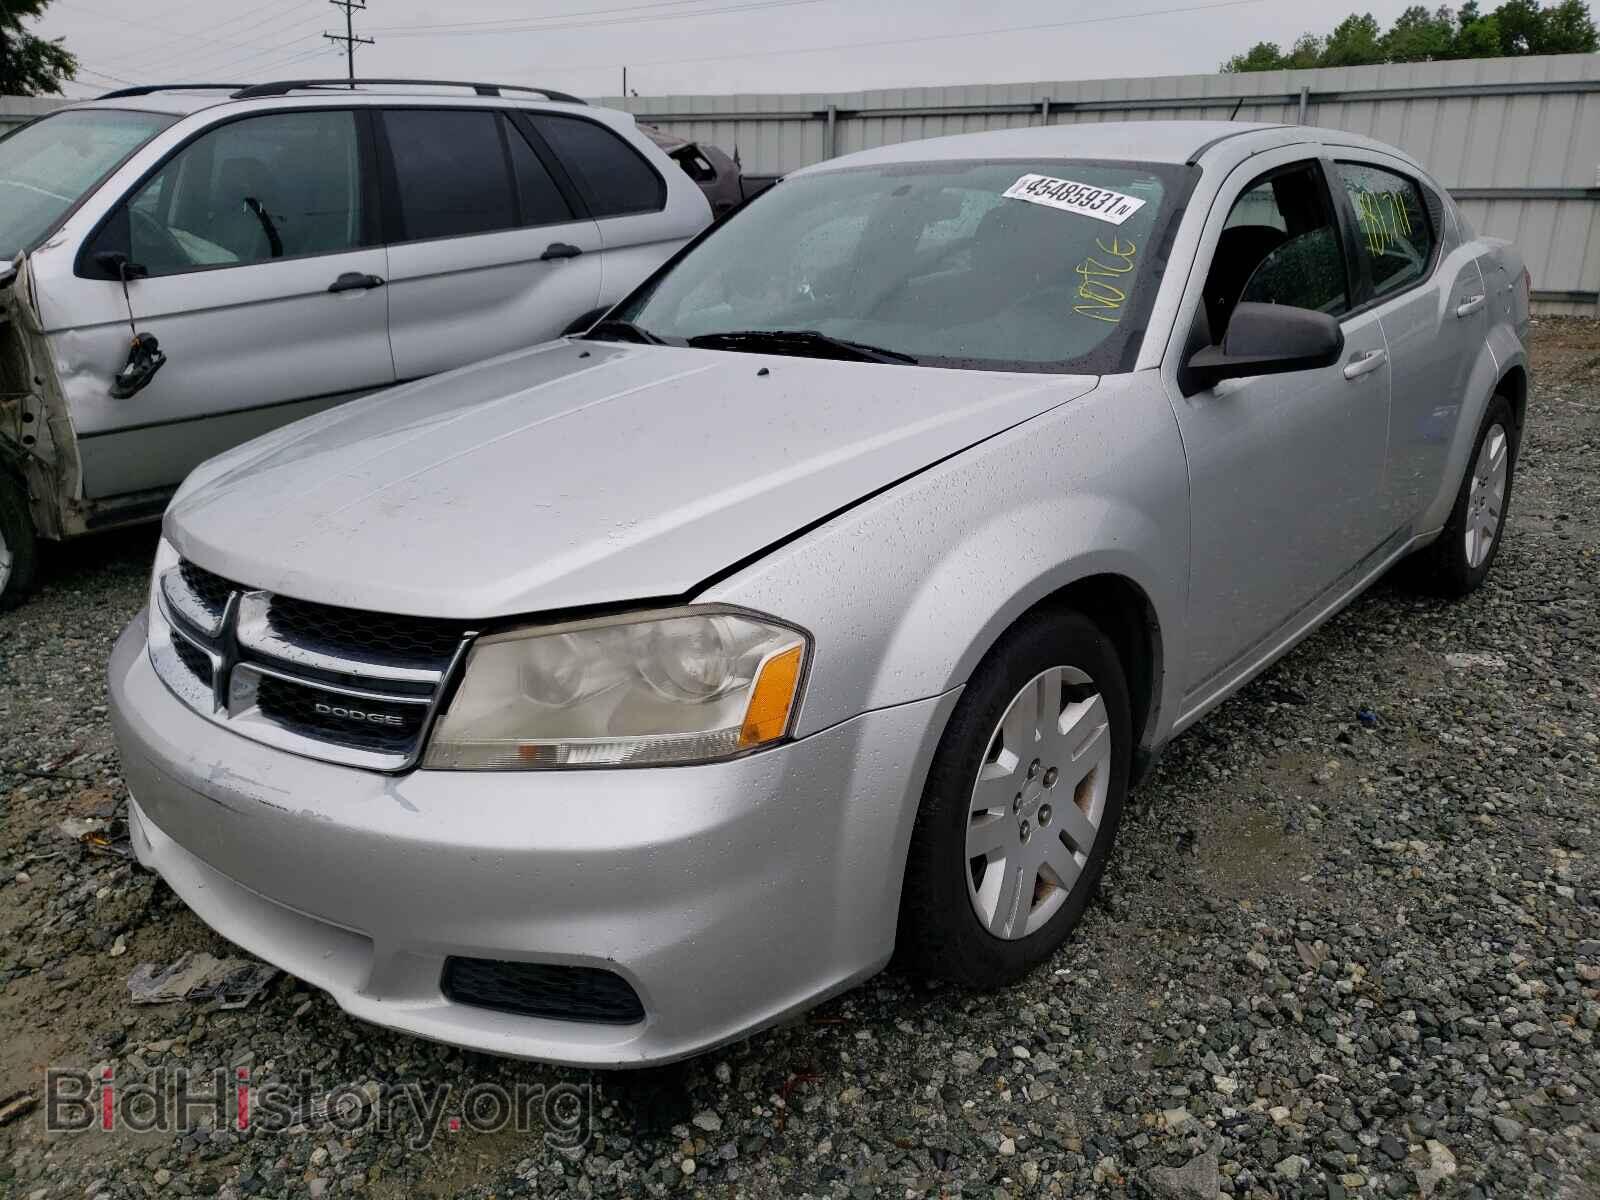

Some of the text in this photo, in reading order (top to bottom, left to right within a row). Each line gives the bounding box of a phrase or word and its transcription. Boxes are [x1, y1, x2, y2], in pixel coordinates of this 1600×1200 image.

[1026, 178, 1125, 214] 45485931
[1116, 204, 1132, 216] N
[315, 703, 404, 726] DODGE
